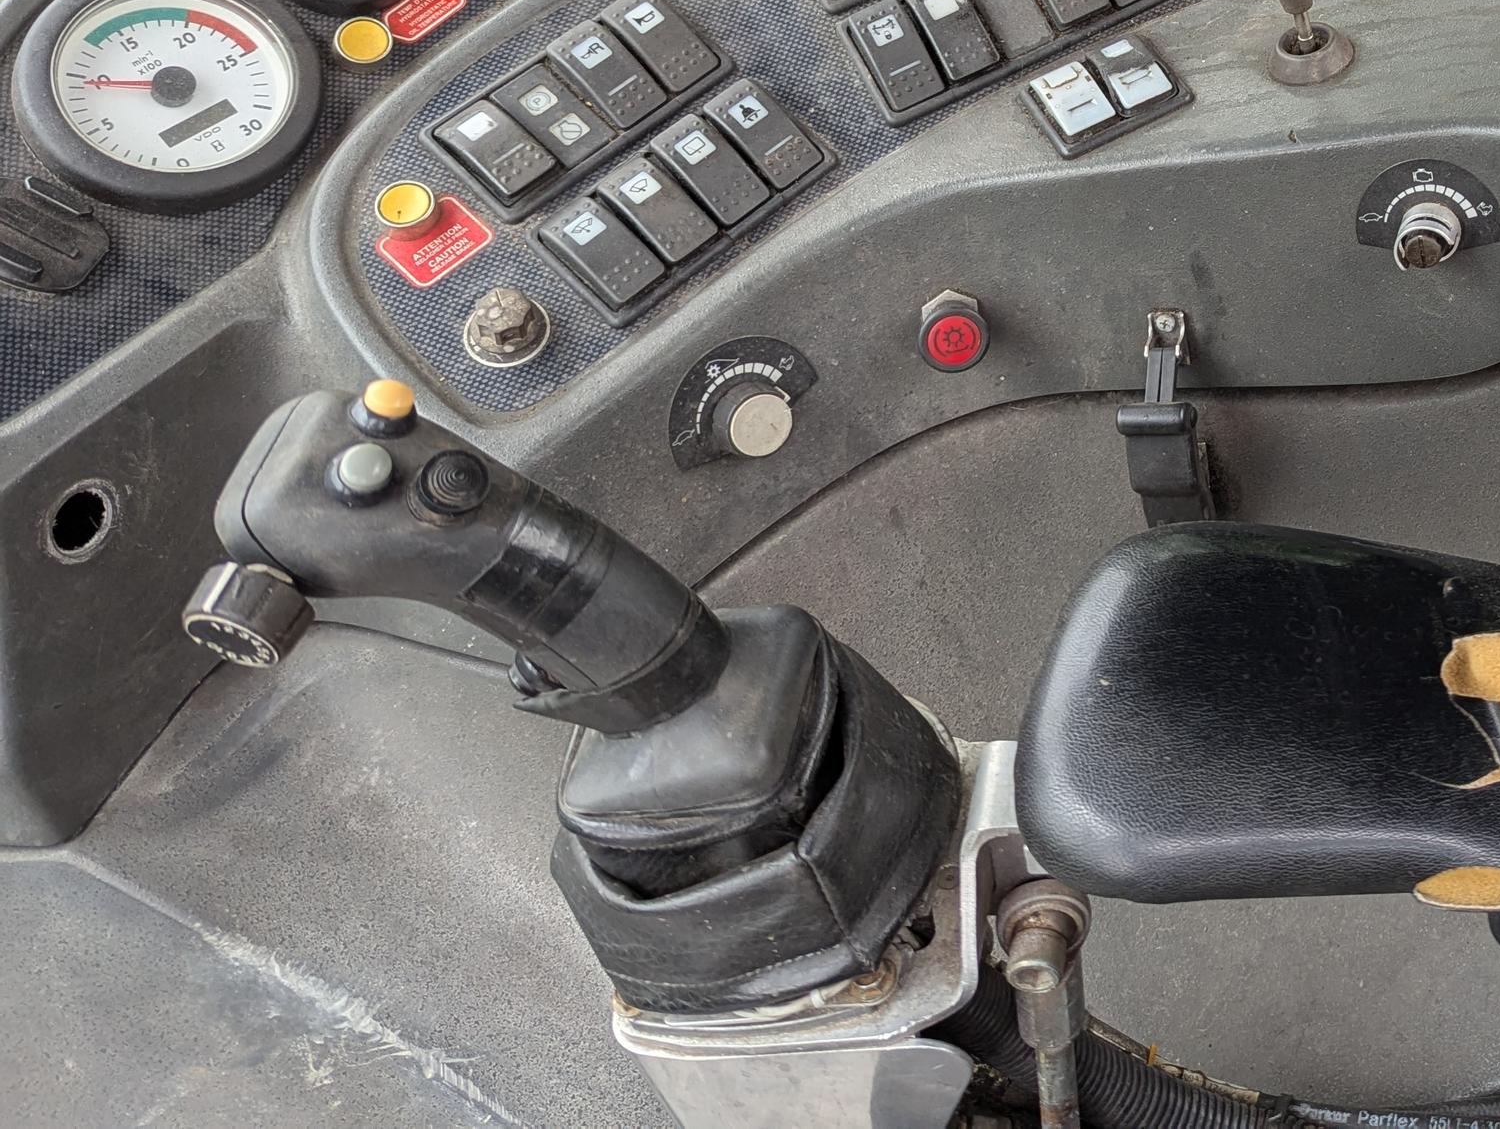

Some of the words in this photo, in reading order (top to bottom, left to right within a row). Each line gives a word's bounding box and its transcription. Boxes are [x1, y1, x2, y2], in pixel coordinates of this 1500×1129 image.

[408, 0, 447, 27] HYDROSTATIC
[418, 0, 458, 28] TEMPERATURE
[120, 37, 139, 52] 15
[173, 32, 196, 49] 20
[137, 59, 163, 76] x100
[217, 54, 238, 72] 25
[101, 117, 115, 131] 5
[239, 119, 263, 136] 30
[194, 126, 222, 142] VDO
[176, 157, 190, 168] 0
[411, 223, 463, 262] ATTENTION
[427, 237, 470, 268] CAUTION
[431, 254, 457, 274] RELEASE
[456, 241, 476, 256] BRAKE
[1357, 1109, 1419, 1127] Parflex
